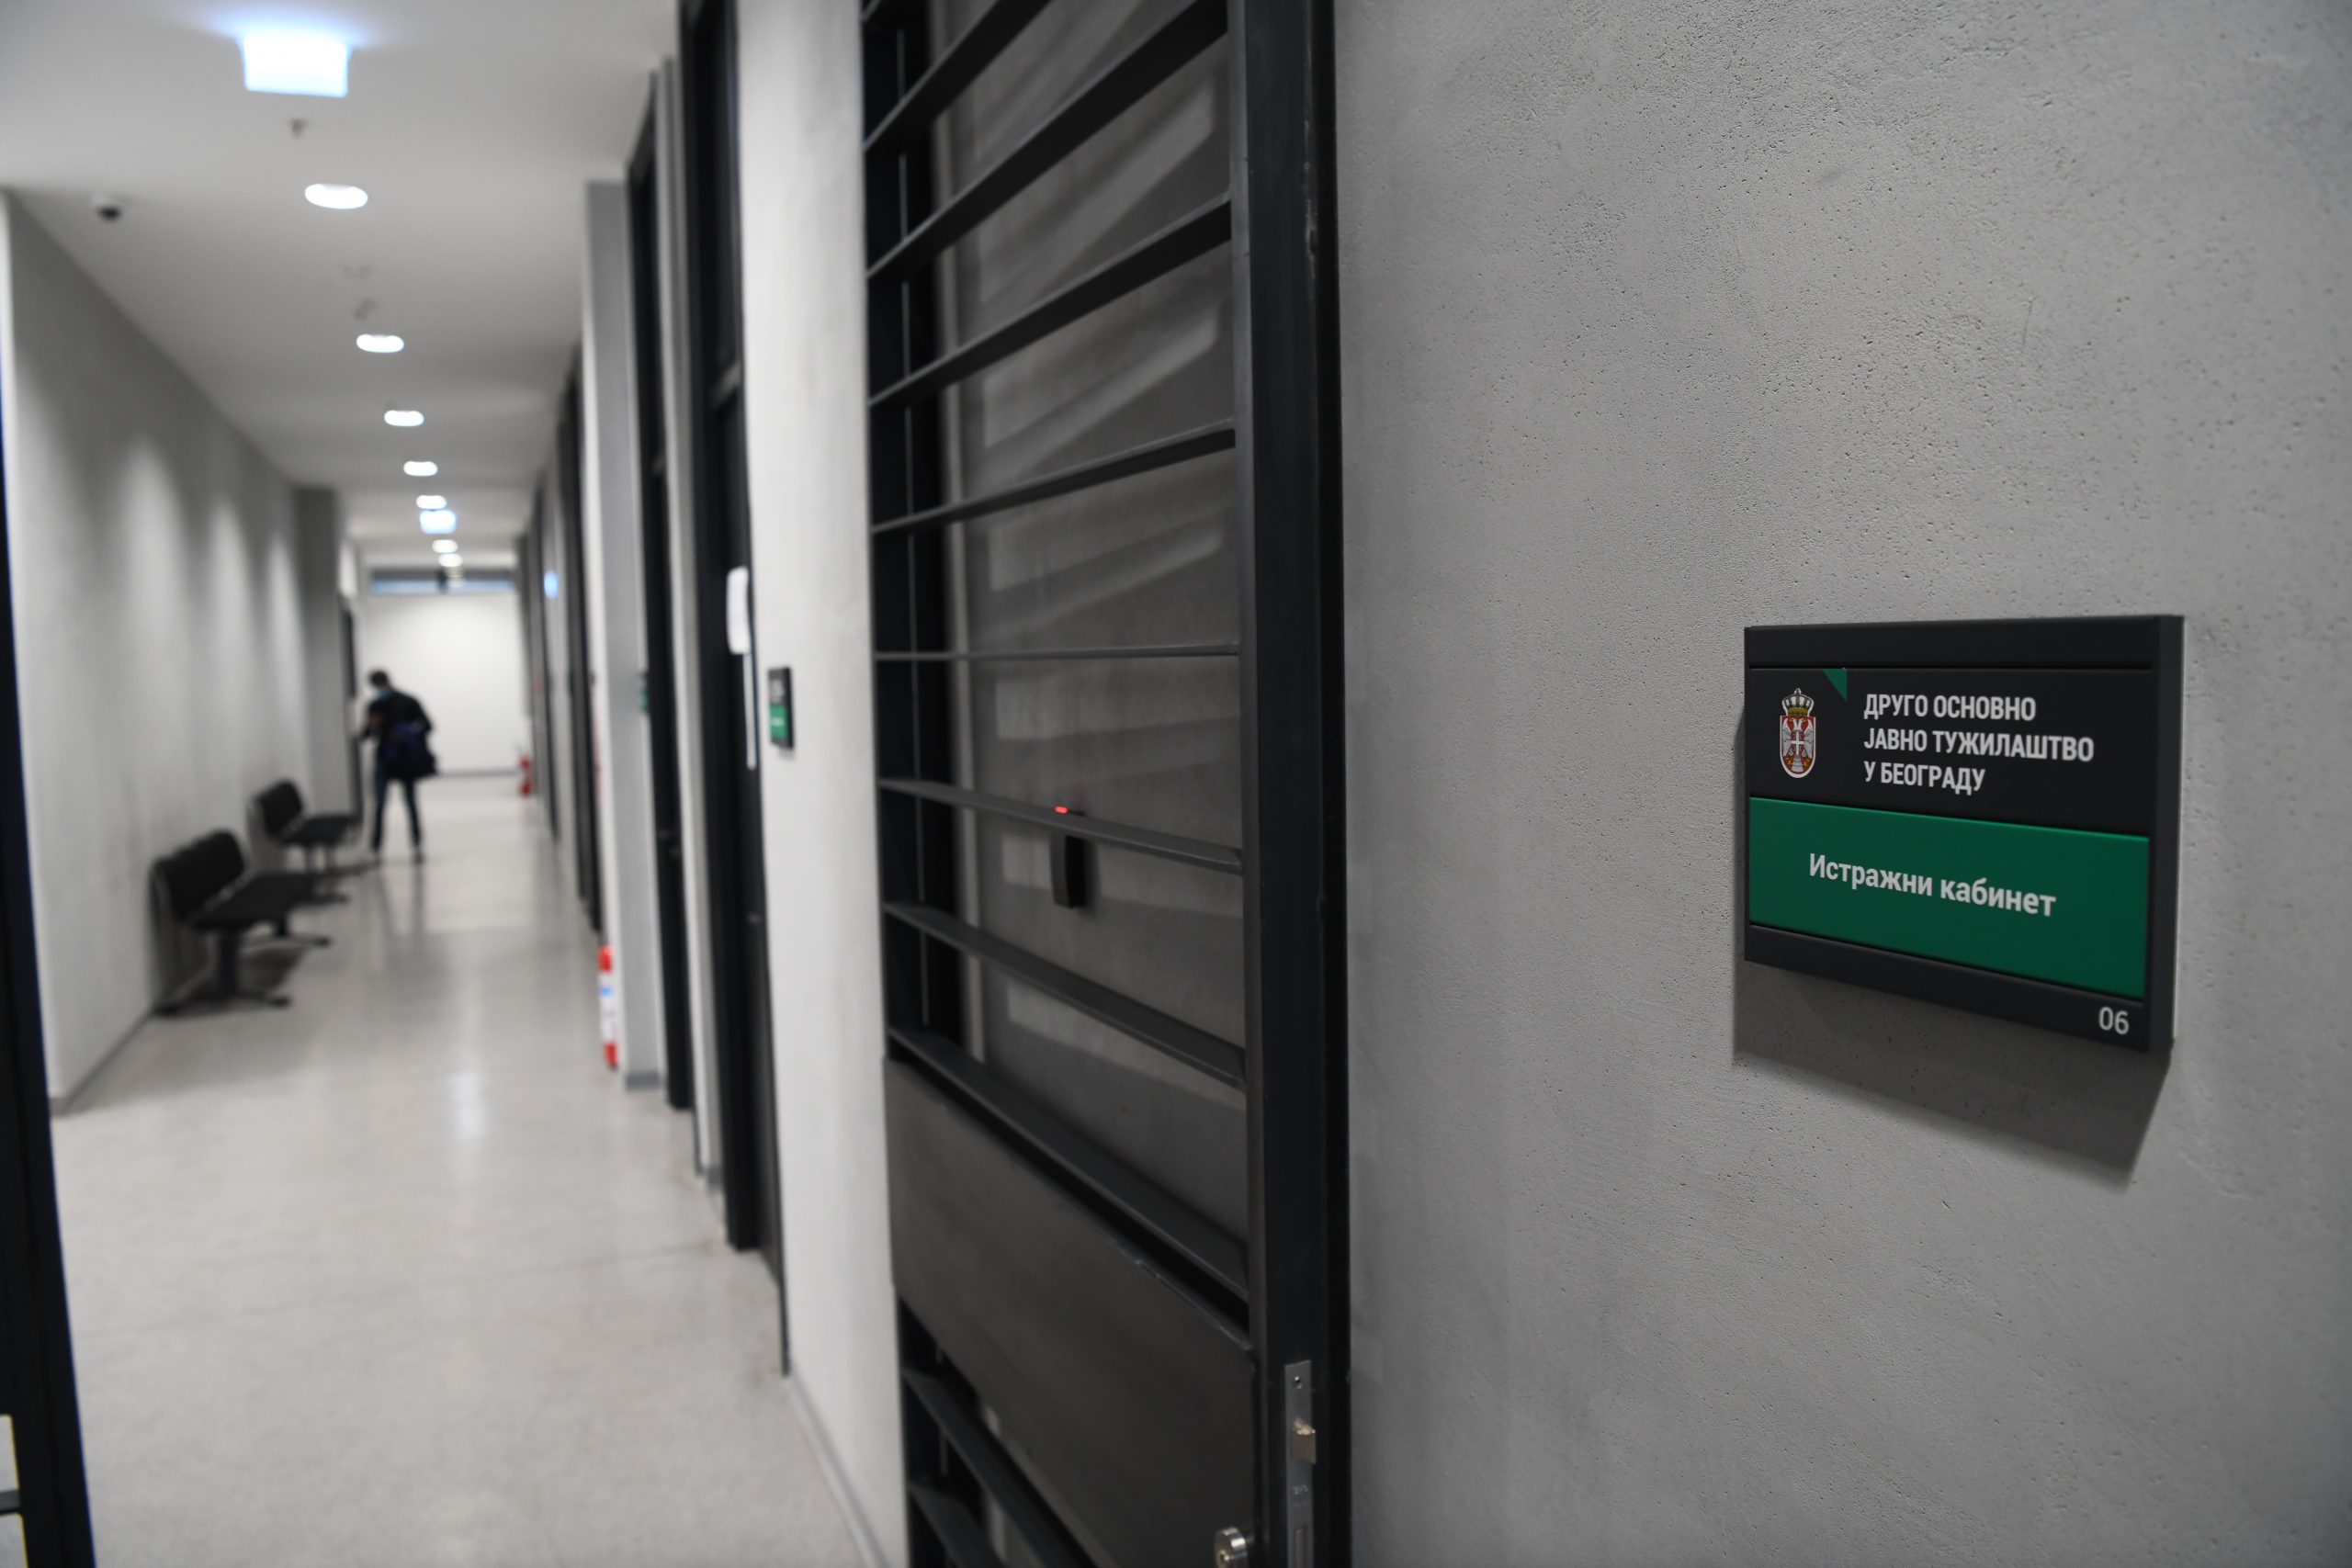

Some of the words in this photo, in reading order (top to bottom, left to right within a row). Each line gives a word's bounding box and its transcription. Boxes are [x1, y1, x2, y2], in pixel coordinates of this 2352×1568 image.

[1863, 694, 1928, 719] ДРУГО
[1933, 695, 2036, 721] ОСНОВНО
[1863, 728, 1927, 751] ЈАВНО
[1932, 731, 2094, 761] ТУЖИЛАШТВО
[1864, 761, 1876, 783] У
[1881, 762, 1985, 795] БЕОГРАДУ
[1809, 852, 1932, 896] Истражни
[1940, 878, 2056, 916] кабинет
[2099, 1007, 2129, 1034] 06
